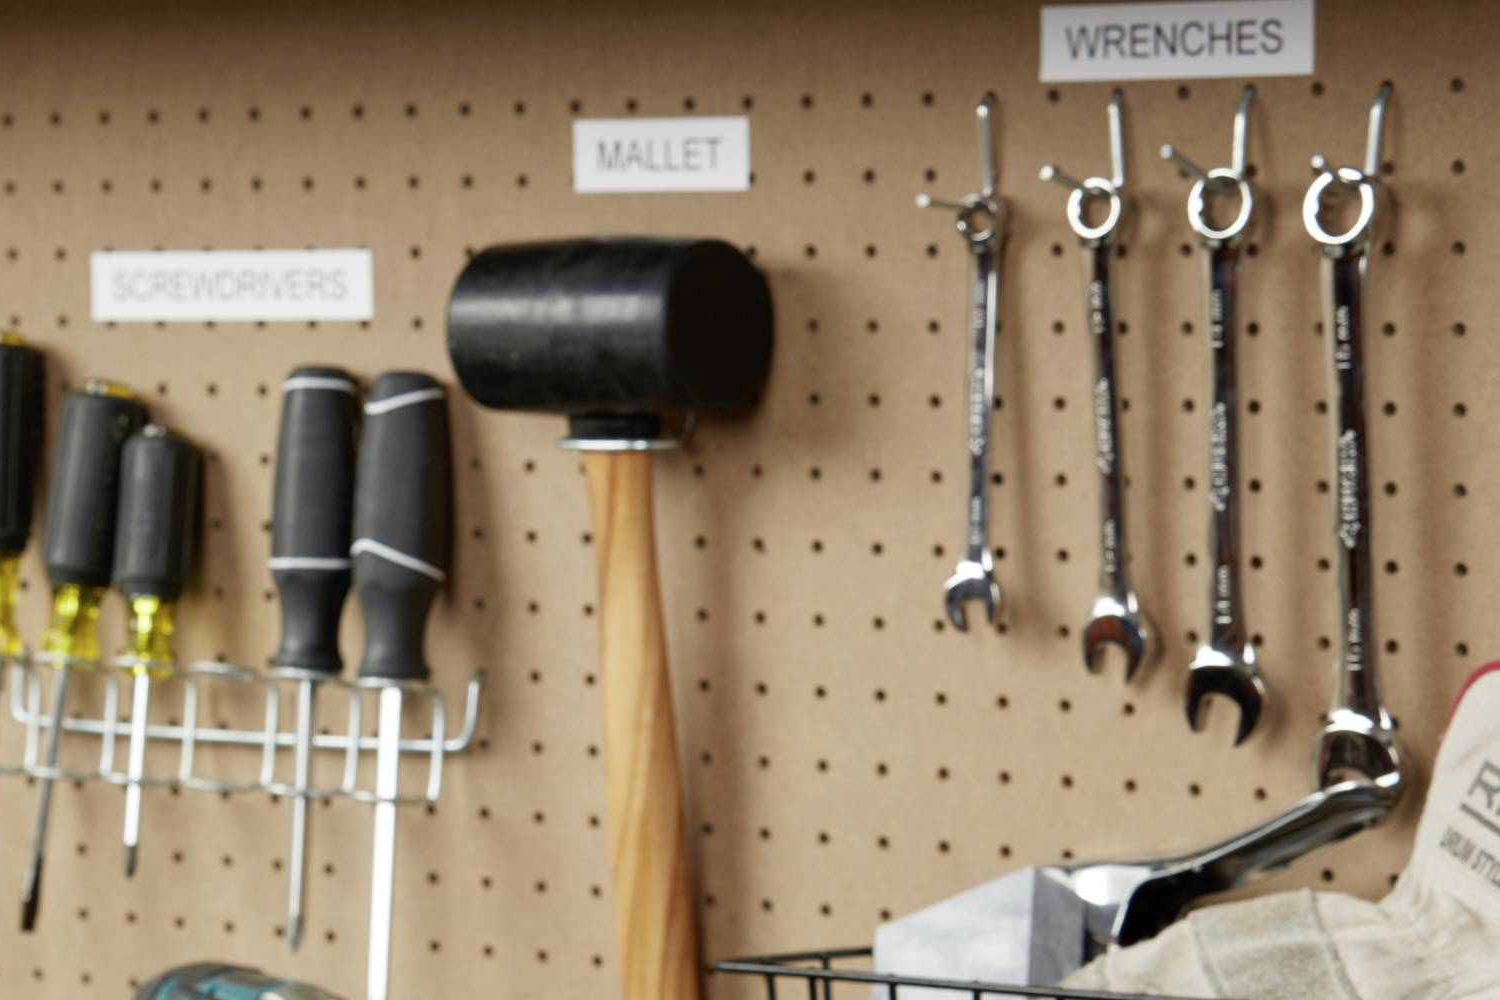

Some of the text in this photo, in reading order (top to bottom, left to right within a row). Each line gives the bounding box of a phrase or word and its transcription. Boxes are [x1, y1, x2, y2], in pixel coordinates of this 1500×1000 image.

[1064, 17, 1285, 60] WRENCHES
[595, 135, 724, 172] MALLET
[110, 267, 350, 303] SCREWDRIVERS
